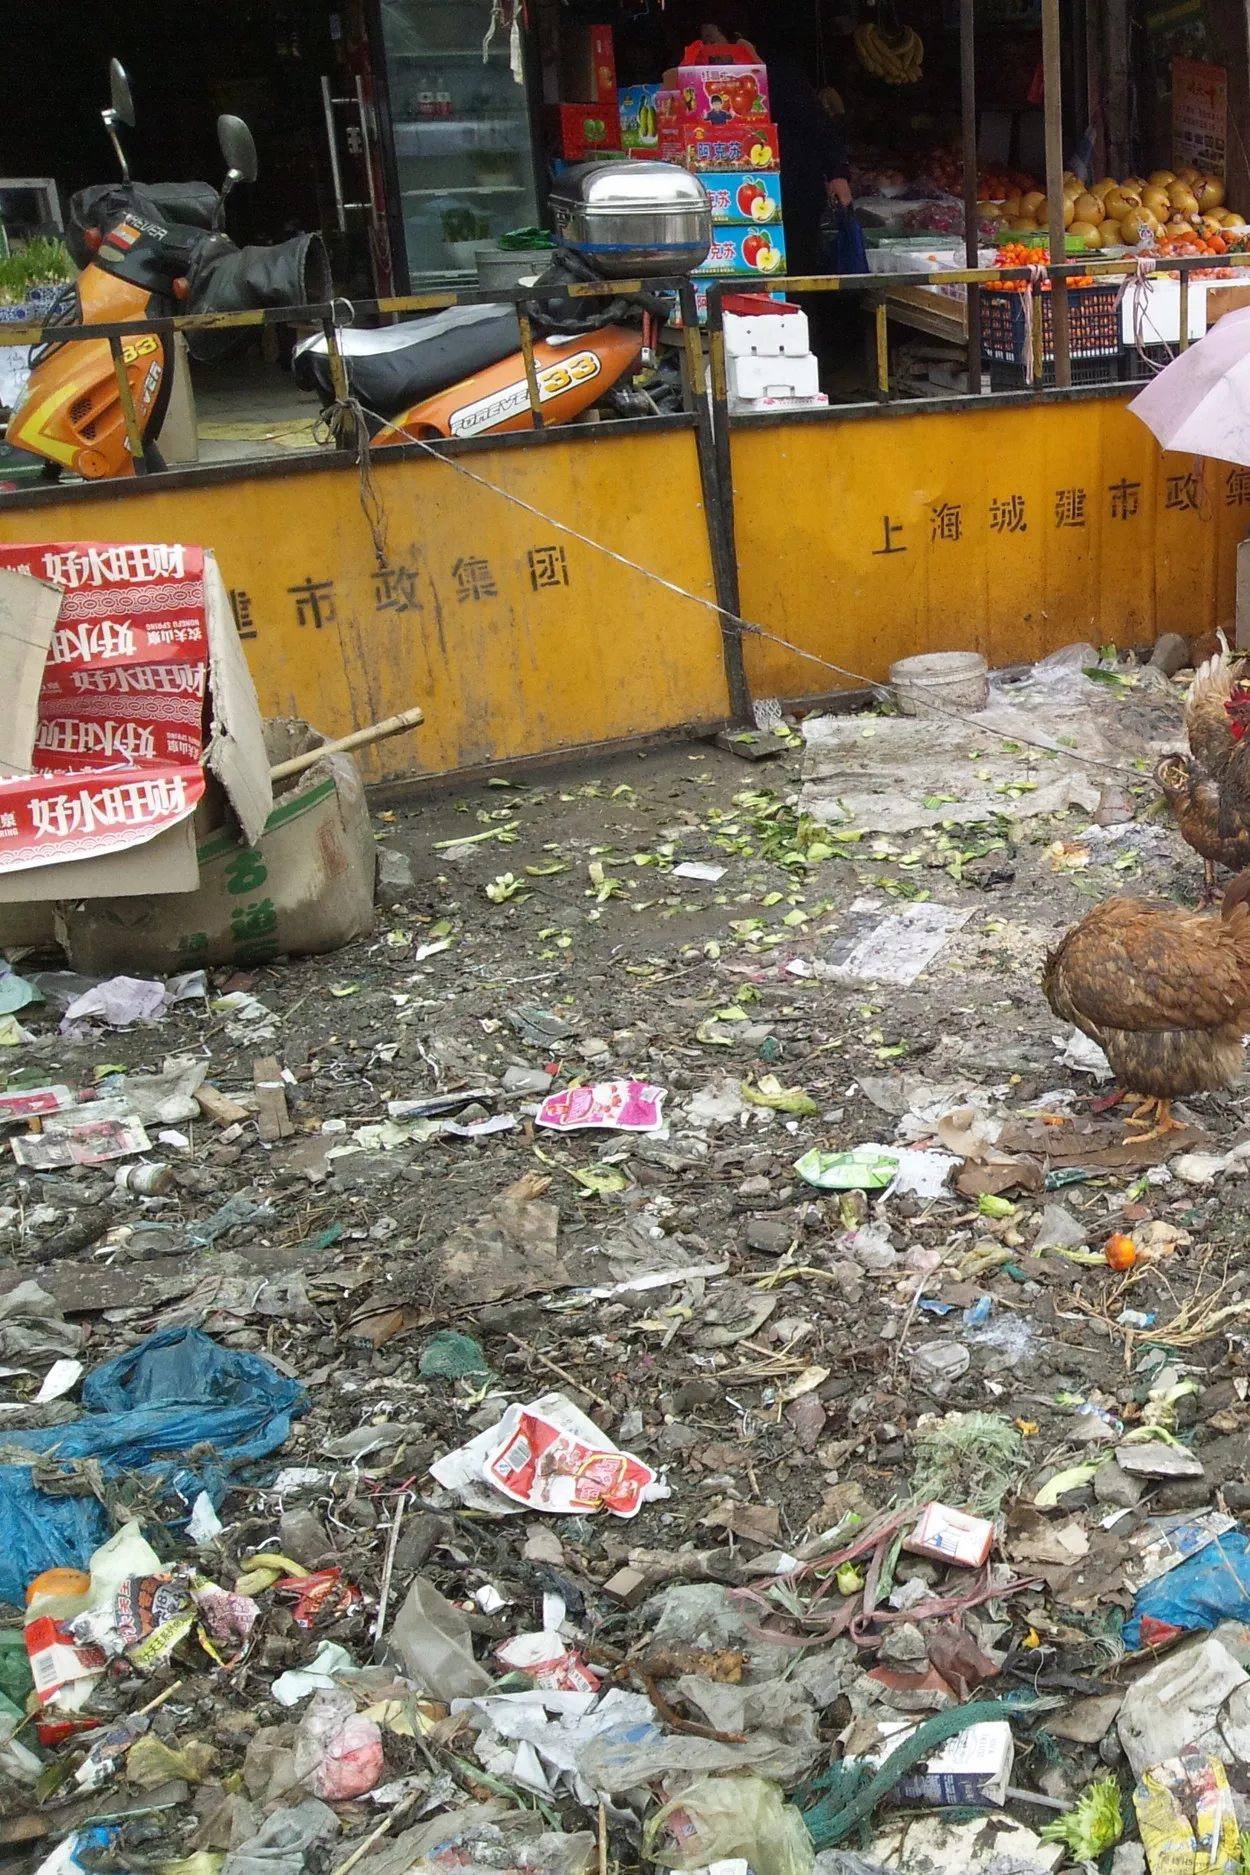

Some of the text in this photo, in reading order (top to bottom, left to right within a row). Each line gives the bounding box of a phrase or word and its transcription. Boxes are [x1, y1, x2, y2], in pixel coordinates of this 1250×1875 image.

[697, 140, 743, 160] 阿克苏
[541, 353, 598, 394] 33
[450, 384, 542, 438] FOREVE
[41, 543, 187, 589] 好水旺财
[147, 626, 203, 646] 农夫山泉
[70, 663, 206, 697] 好水旺财
[27, 775, 188, 840] 好水旺财
